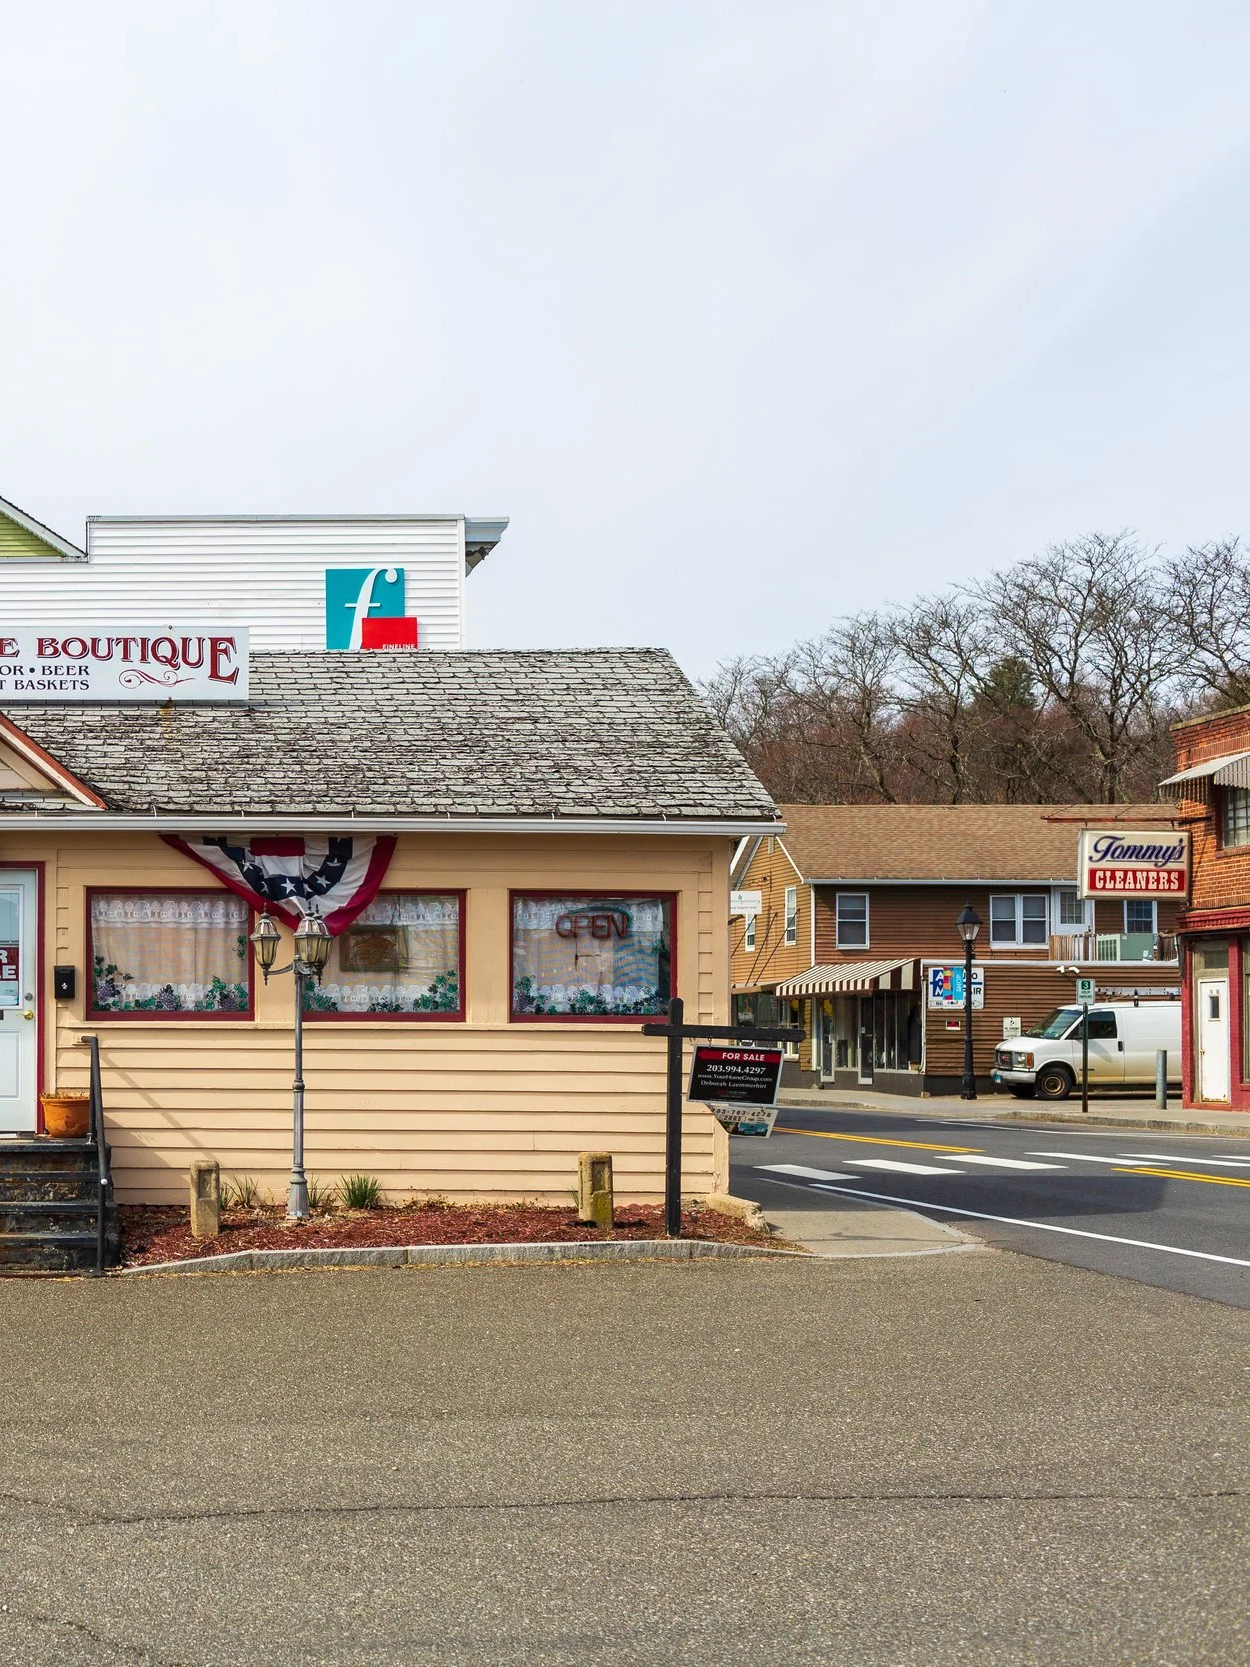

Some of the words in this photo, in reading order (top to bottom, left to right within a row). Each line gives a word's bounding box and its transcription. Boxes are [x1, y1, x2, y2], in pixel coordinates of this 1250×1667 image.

[36, 636, 239, 685] BOUTIQUE
[41, 665, 90, 676] BEER
[14, 679, 90, 691] BASKETS
[1088, 835, 1186, 868] Tommy's
[1095, 870, 1179, 890] CLEANERS
[556, 912, 628, 938] OPEN
[1083, 981, 1089, 989] 3
[722, 1052, 740, 1060] FOR
[743, 1053, 765, 1061] SALE
[706, 1064, 767, 1075] 203.994.4297
